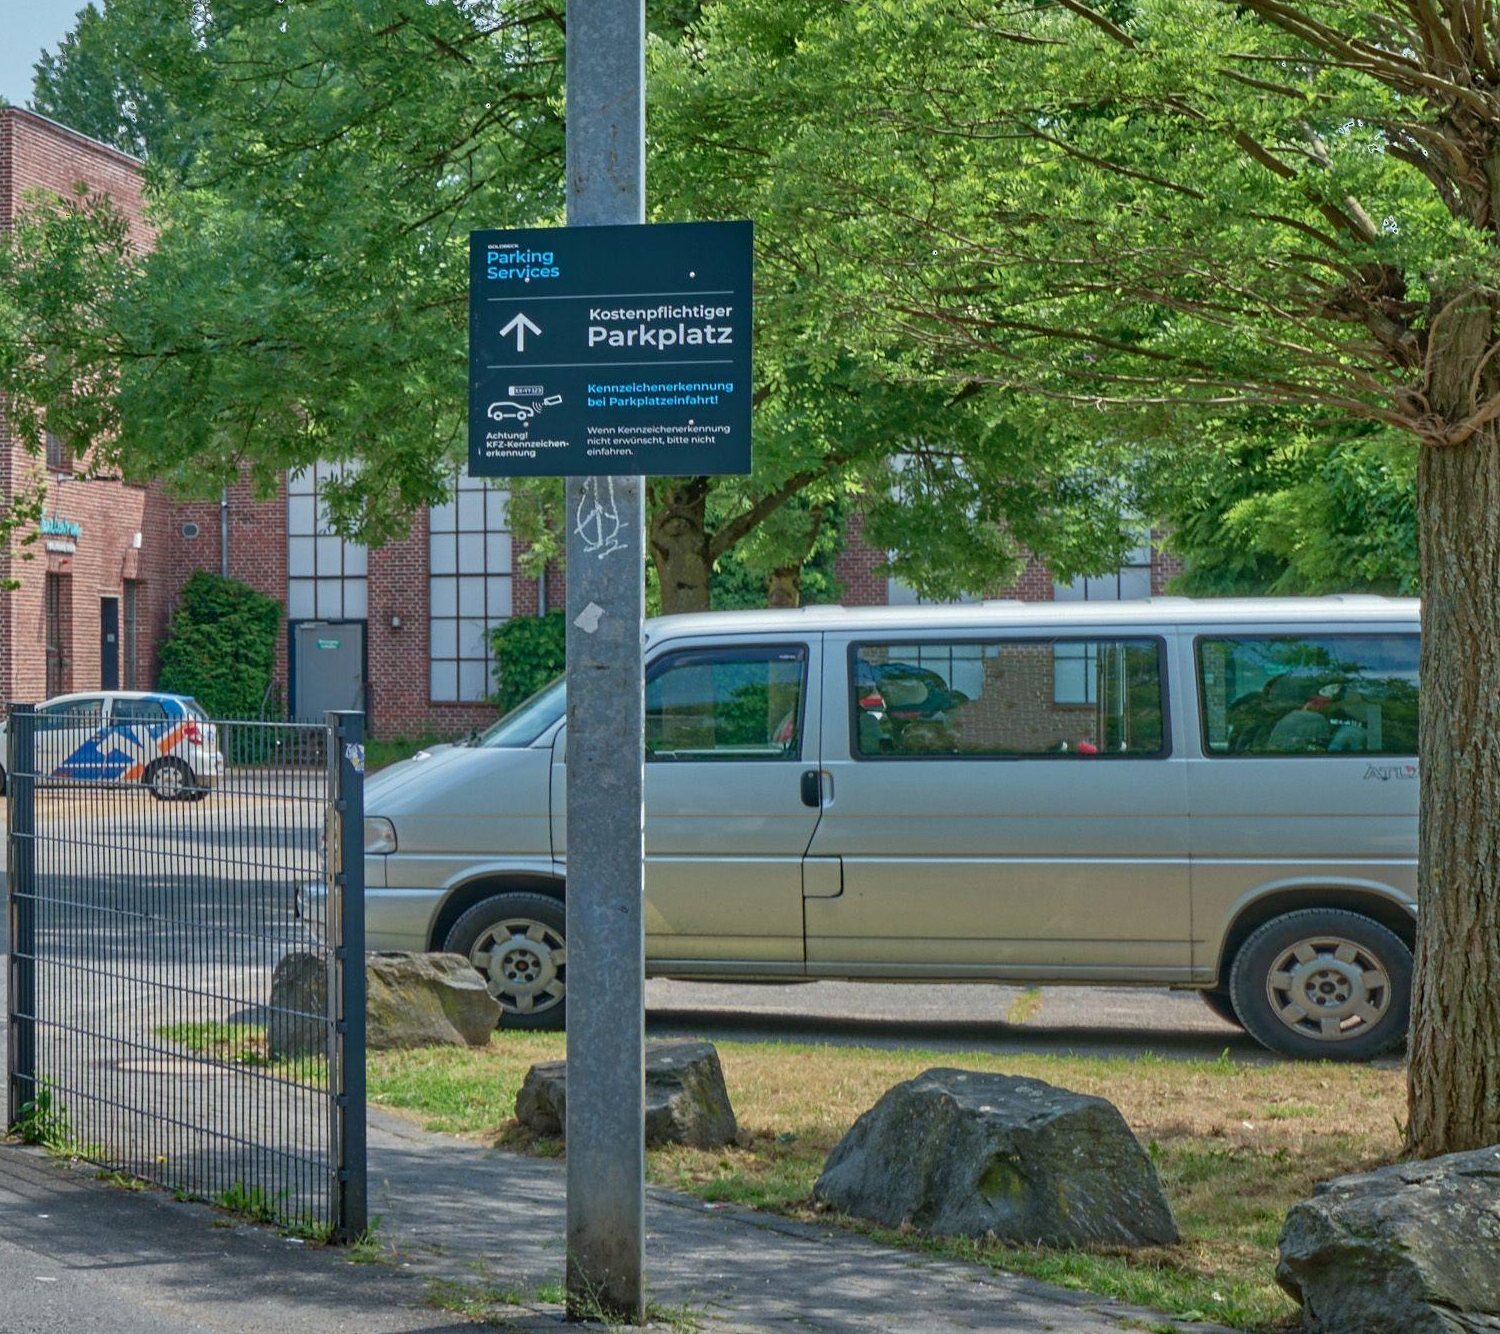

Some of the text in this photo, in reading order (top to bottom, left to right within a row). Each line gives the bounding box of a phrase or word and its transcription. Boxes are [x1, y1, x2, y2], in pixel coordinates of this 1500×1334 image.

[487, 249, 554, 265] Parking
[487, 264, 560, 280] Services
[589, 305, 733, 322] Kostenpflichtiger
[588, 322, 733, 351] Parkplatz
[588, 382, 734, 394] Kennzeichenerkennung
[587, 395, 719, 408] bei Parkplatzeinfahrt!
[586, 424, 731, 435] Wenn Kennzeichenerkennung
[486, 432, 528, 441] Achtung!
[586, 435, 716, 446] nicht erwünscht, bitte nicht
[486, 440, 570, 448] KFZ-Kennzeichen-
[486, 449, 536, 458] erkennung
[586, 447, 634, 456] einfahren.
